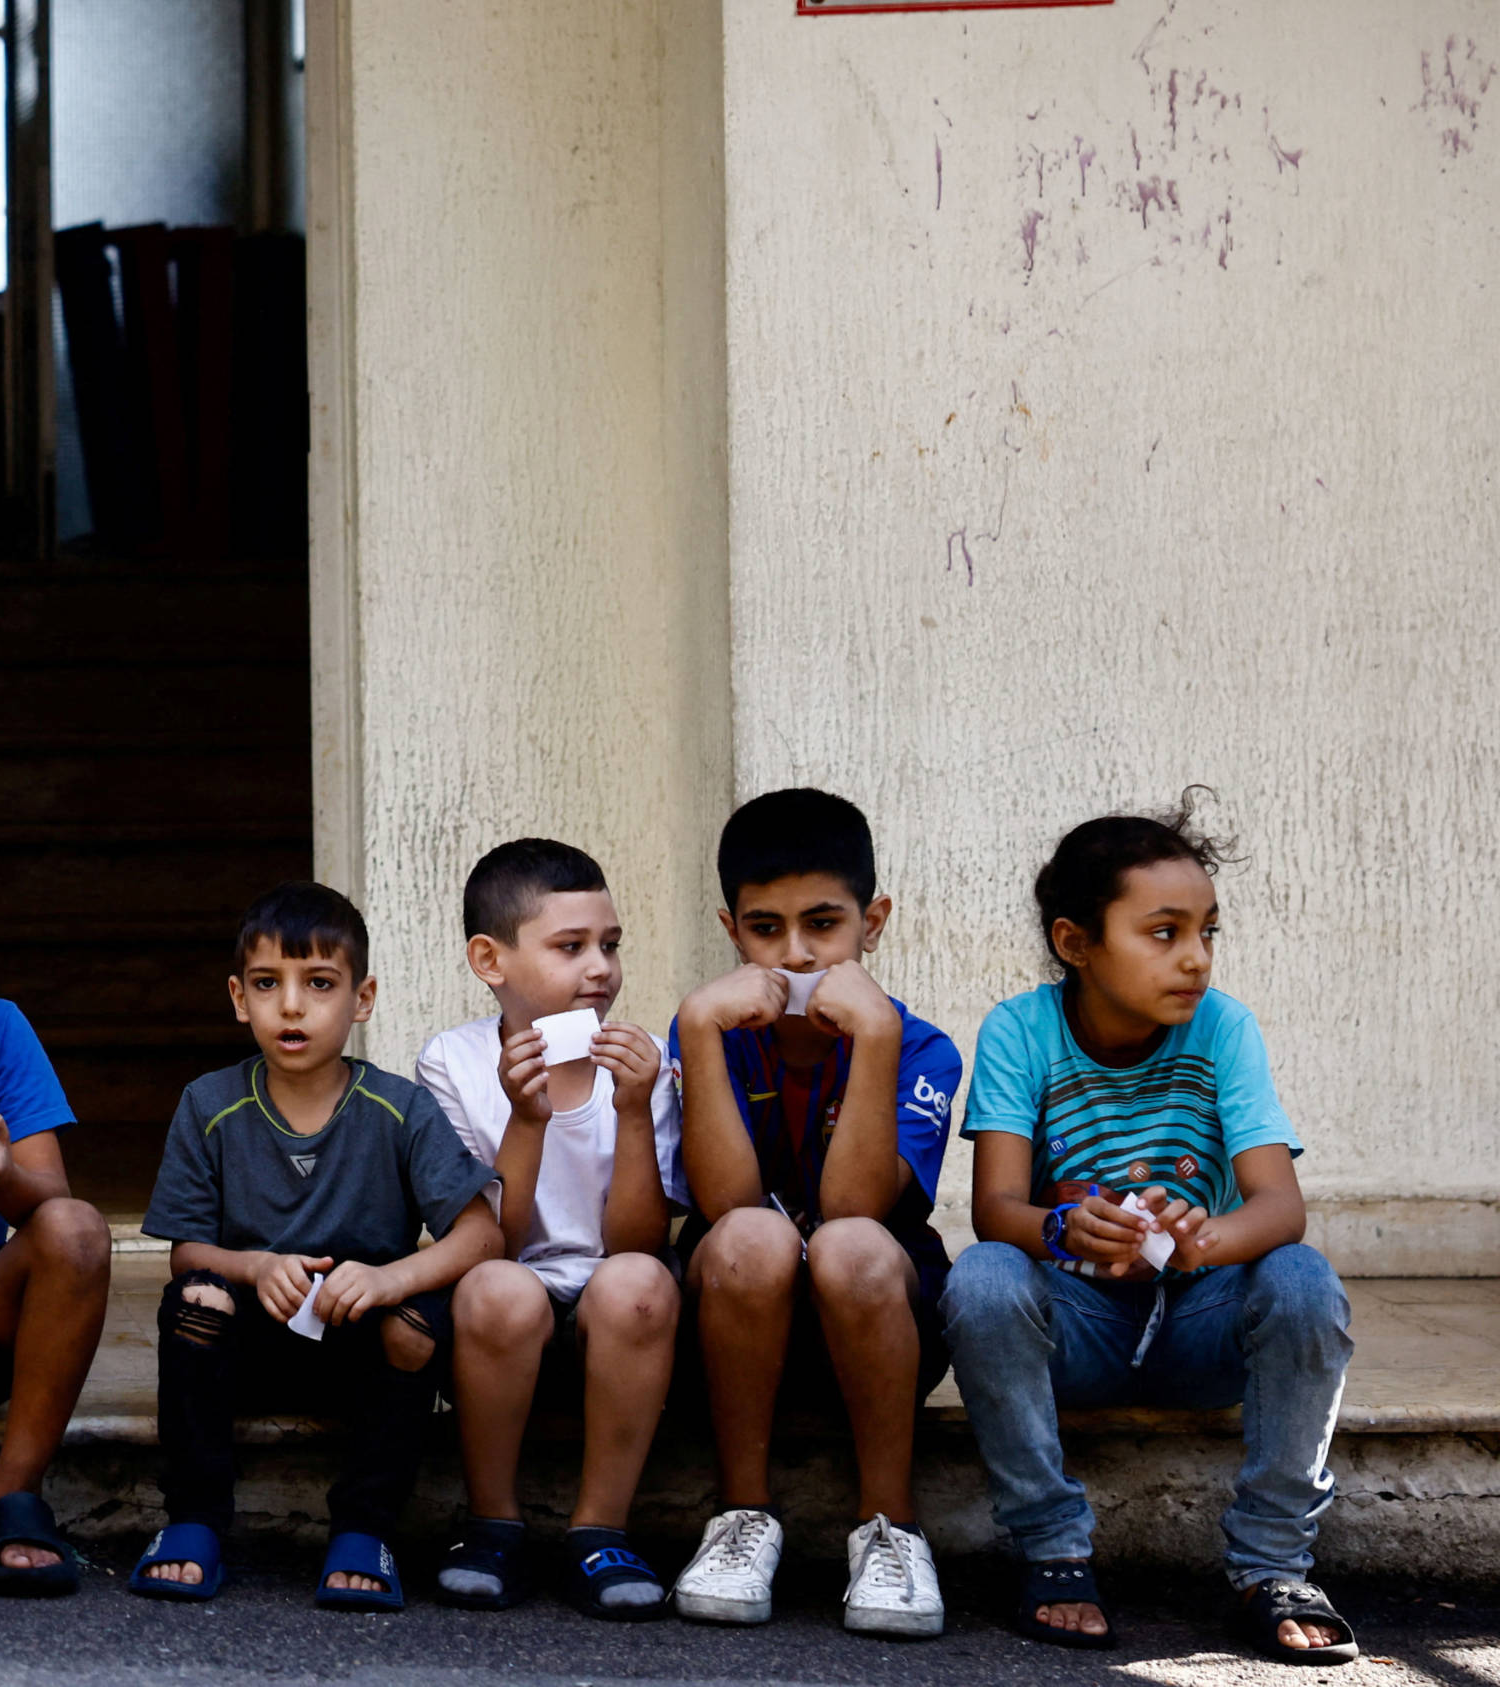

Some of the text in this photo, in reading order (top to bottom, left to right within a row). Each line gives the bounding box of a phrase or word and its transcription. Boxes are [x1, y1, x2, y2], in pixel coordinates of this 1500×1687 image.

[1051, 1139, 1064, 1152] m
[1133, 1165, 1147, 1179] m
[1179, 1158, 1196, 1176] m
